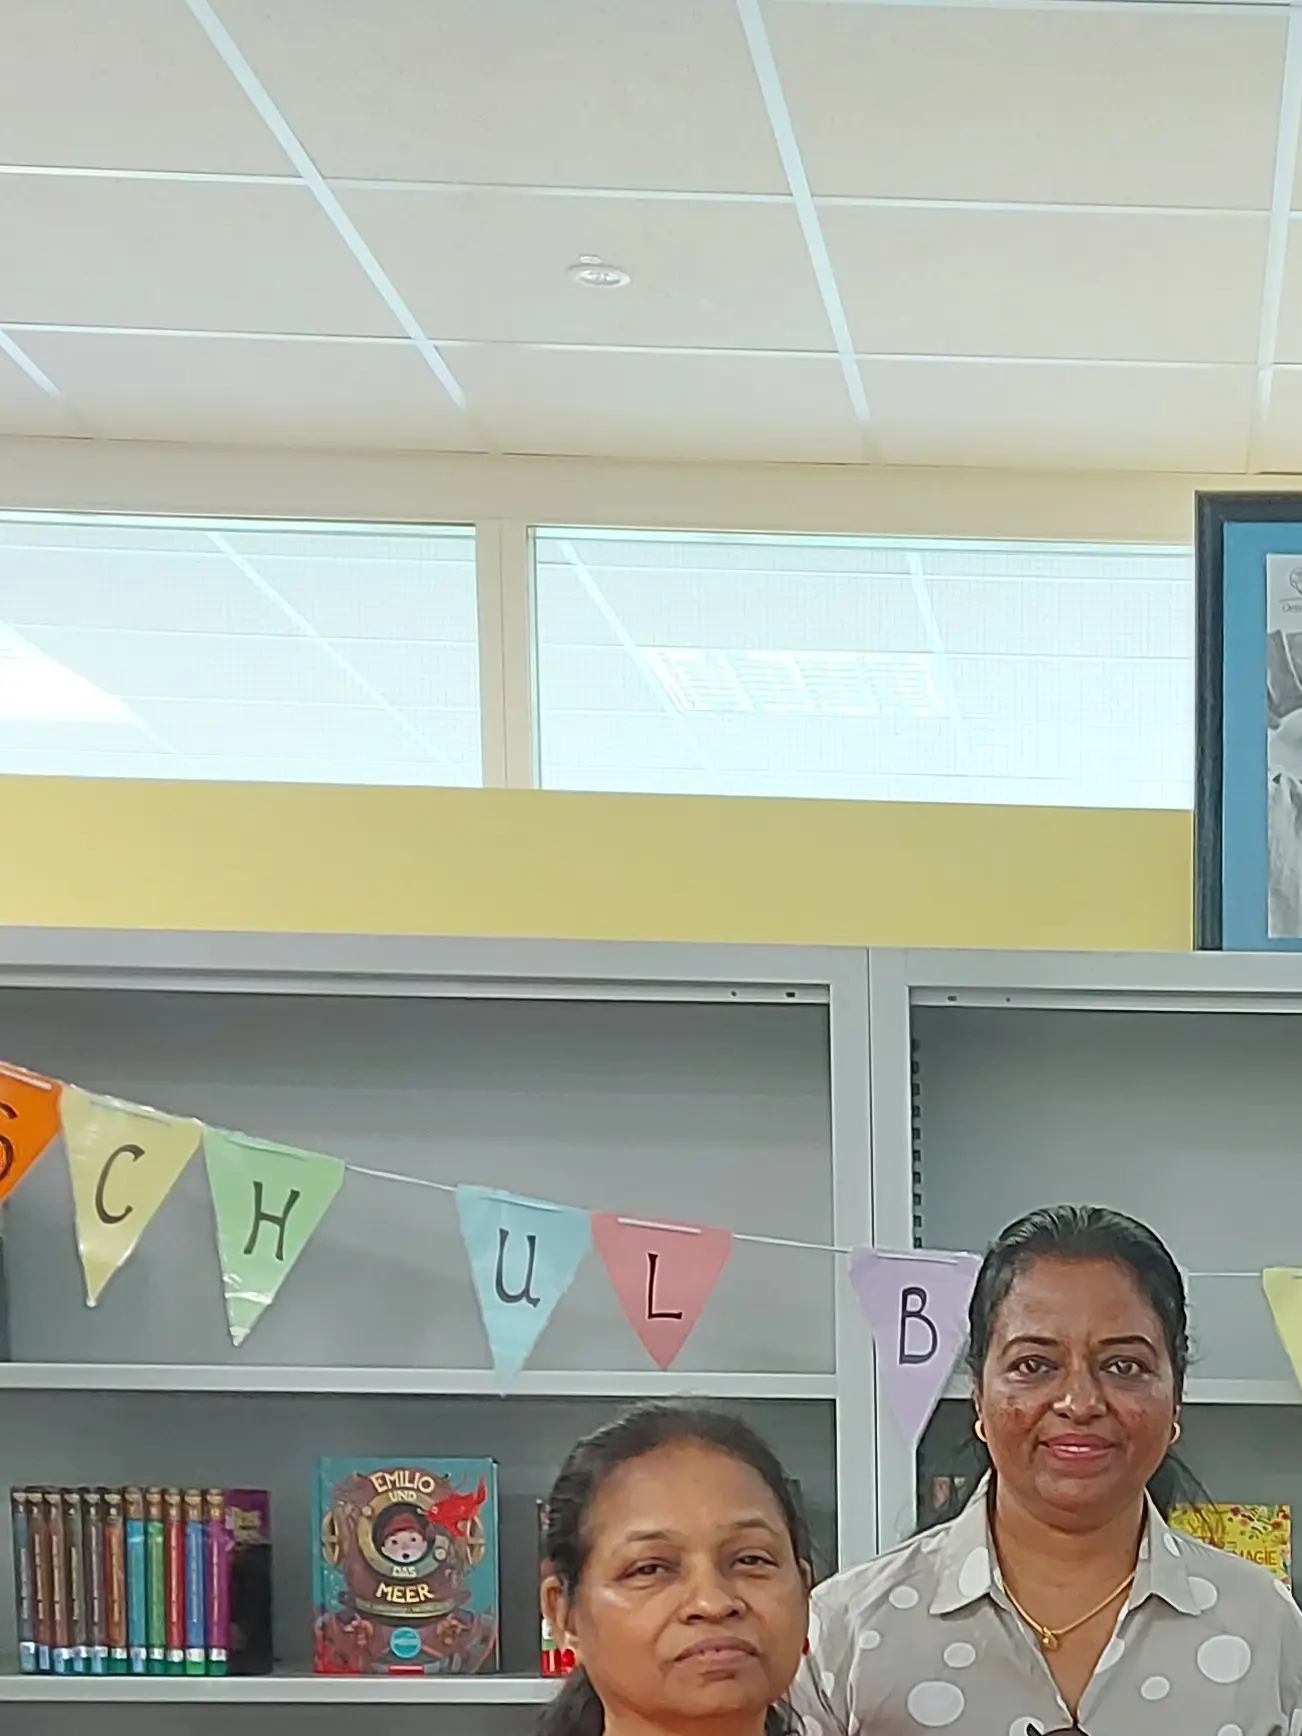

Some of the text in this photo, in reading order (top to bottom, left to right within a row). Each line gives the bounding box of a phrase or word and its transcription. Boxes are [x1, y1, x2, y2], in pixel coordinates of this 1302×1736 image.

[369, 1470, 436, 1493] EMILIO
[388, 1490, 418, 1502] UND
[391, 1566, 418, 1577] DAS
[375, 1582, 435, 1603] MEER
